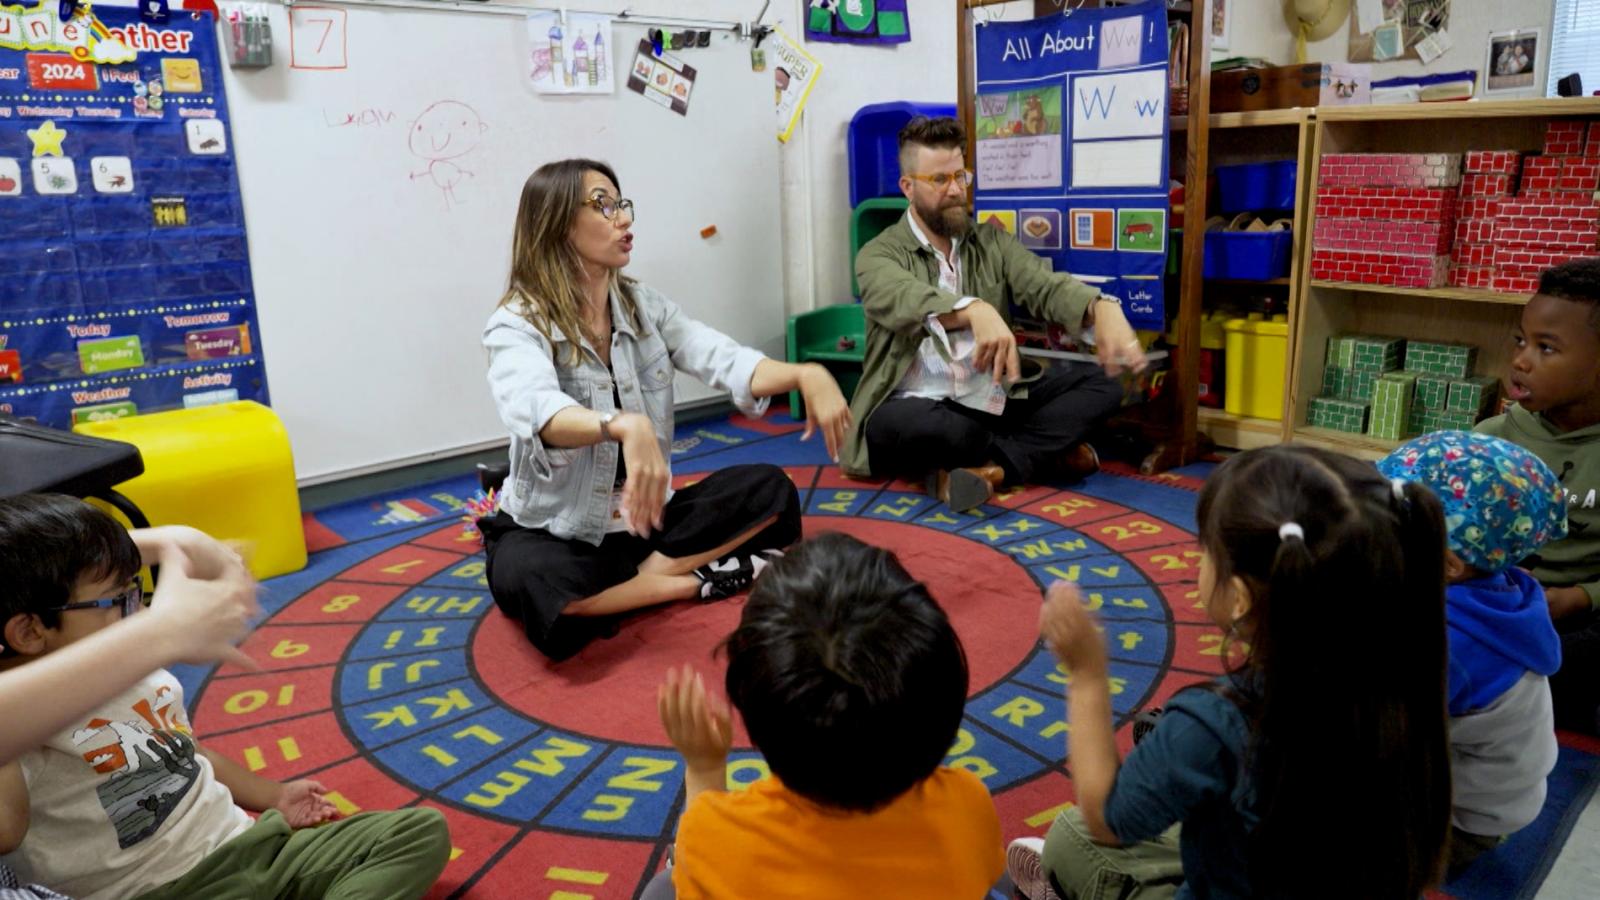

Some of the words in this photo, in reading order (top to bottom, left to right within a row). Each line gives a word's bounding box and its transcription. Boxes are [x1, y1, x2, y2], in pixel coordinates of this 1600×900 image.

[307, 19, 334, 53] 7
[1002, 37, 1032, 61] All
[1040, 24, 1095, 57] About
[41, 64, 86, 80] 2024
[1079, 85, 1116, 120] W
[1136, 99, 1159, 118] w
[41, 163, 50, 174] 5
[99, 163, 107, 173] 6
[1128, 290, 1152, 300] Letter
[1130, 303, 1153, 313] Cards
[163, 311, 230, 328] Tomorrow
[66, 323, 111, 338] Today
[194, 339, 234, 351] Tuesday
[71, 387, 131, 404] Weather
[1041, 499, 1097, 517] 24
[1101, 521, 1162, 540] 23
[321, 595, 361, 613] 8
[224, 684, 296, 714] 10
[243, 736, 302, 772] 11
